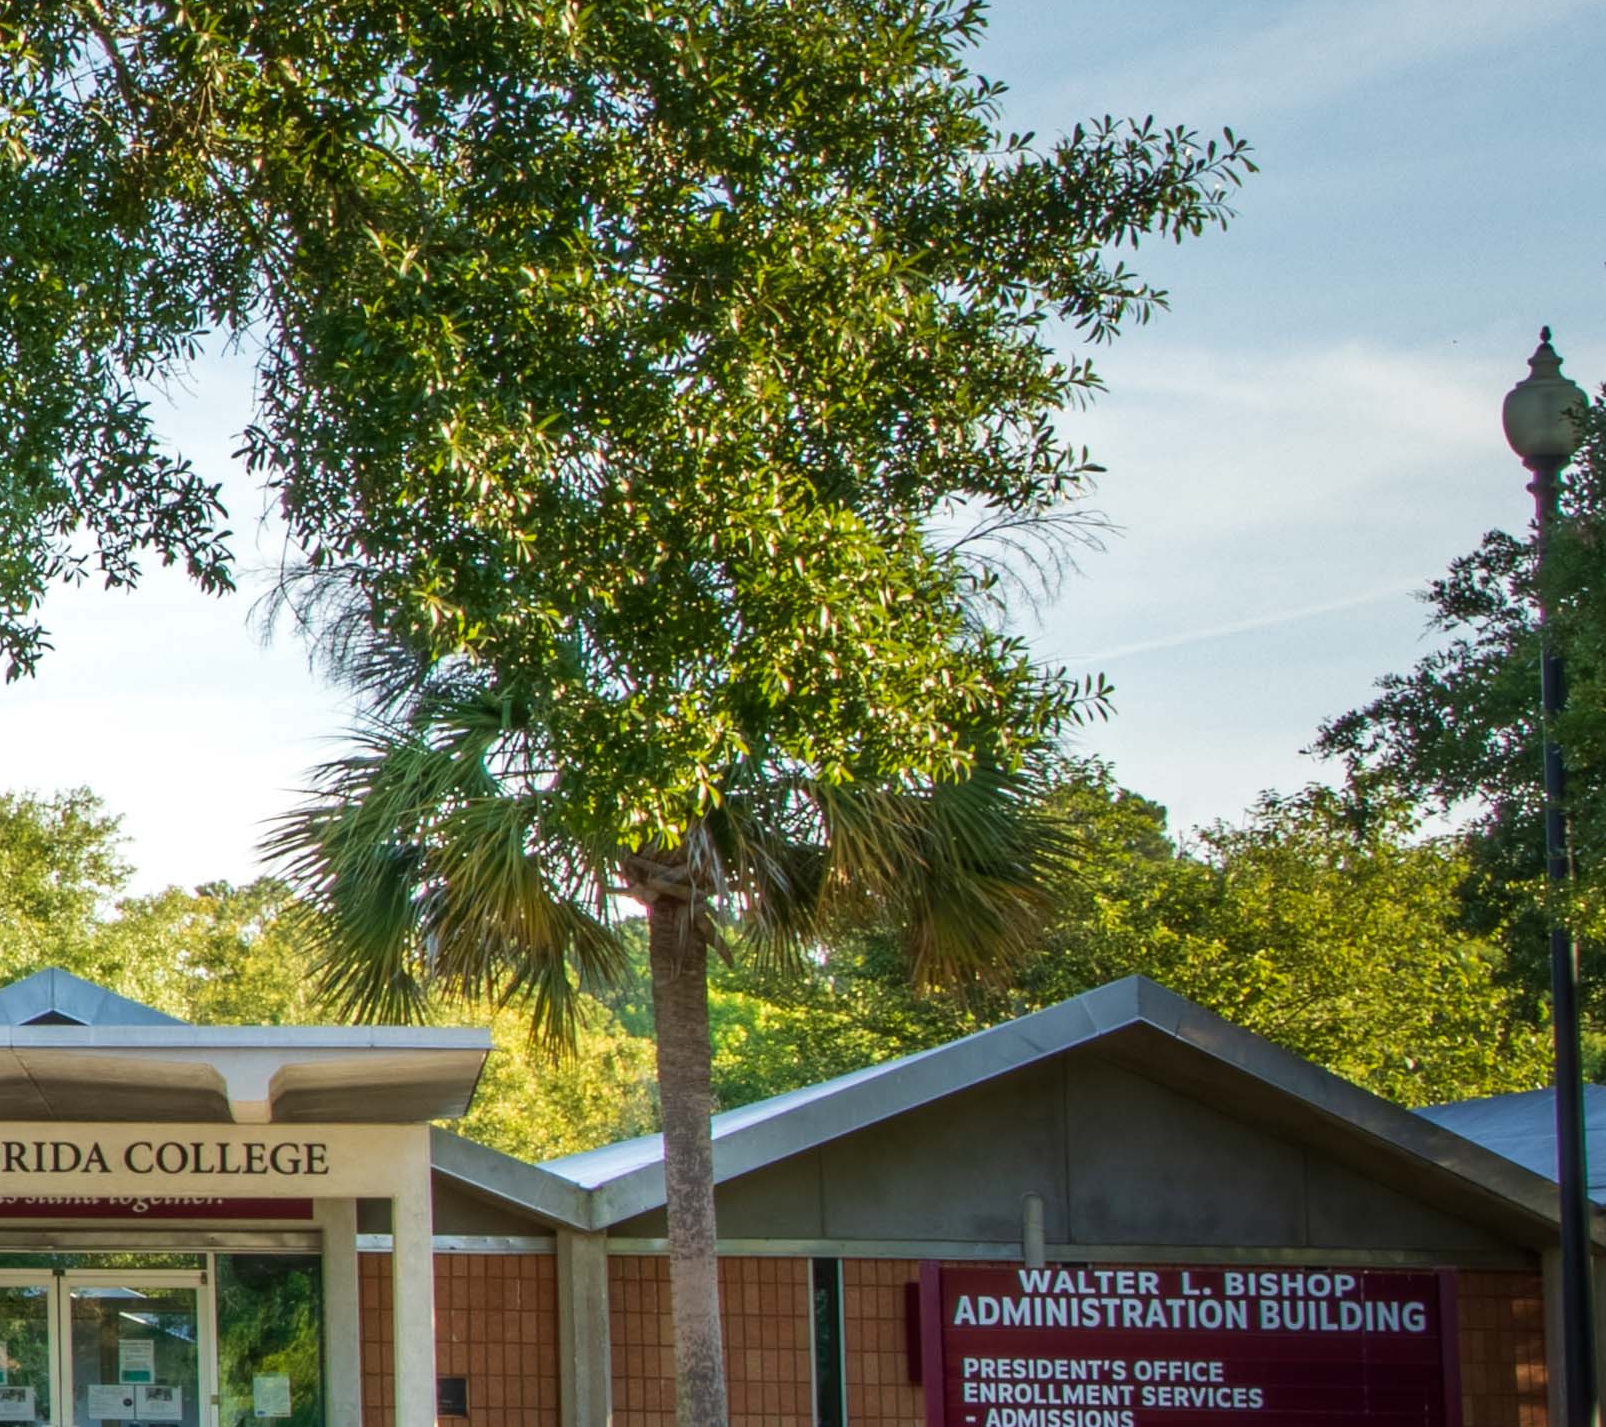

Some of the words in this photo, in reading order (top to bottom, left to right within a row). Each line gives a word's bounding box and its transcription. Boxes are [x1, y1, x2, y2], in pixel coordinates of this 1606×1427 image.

[123, 1141, 330, 1176] COLLEGE
[1016, 1268, 1160, 1295] WALTER
[1181, 1270, 1212, 1296] L.
[1224, 1272, 1356, 1298] BISHOP
[953, 1294, 1248, 1329] ADMINISTRATION
[1259, 1298, 1426, 1332] BUILDING
[962, 1357, 1127, 1381] PRESIDENT'S
[1133, 1359, 1225, 1383] OFFICE
[963, 1382, 1135, 1406] ENROLLMENT
[1141, 1385, 1264, 1409] SERVICES
